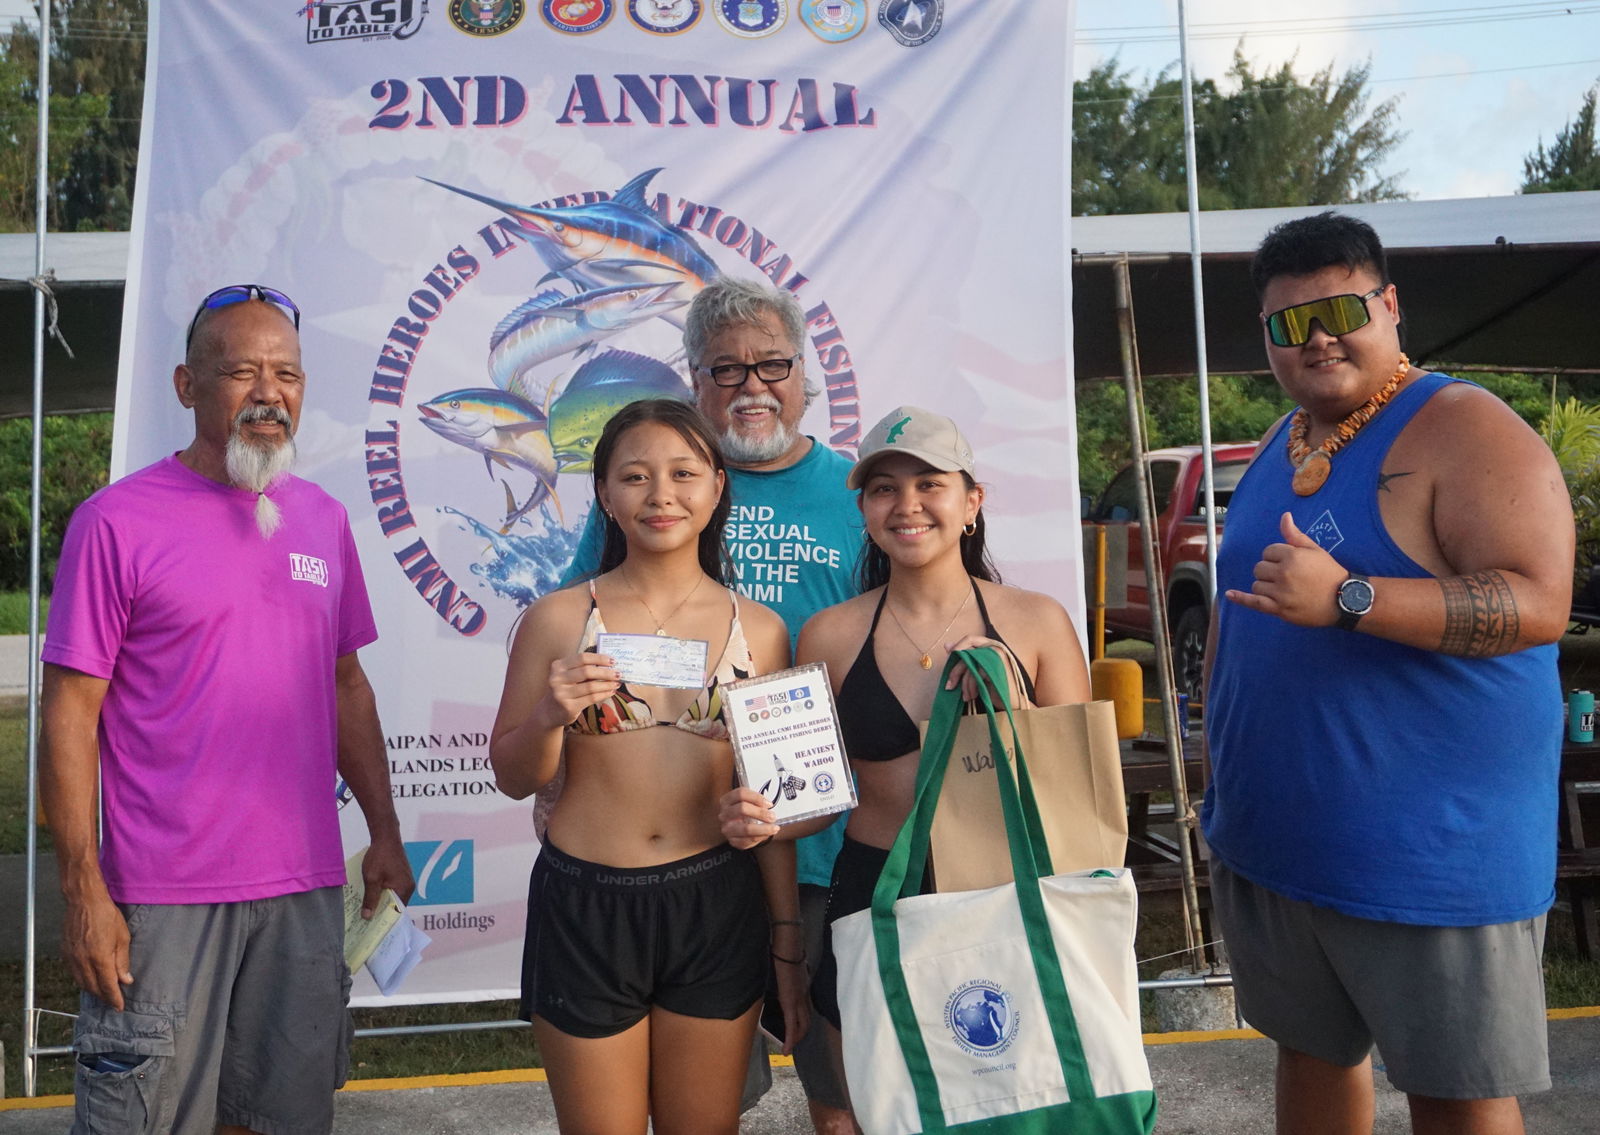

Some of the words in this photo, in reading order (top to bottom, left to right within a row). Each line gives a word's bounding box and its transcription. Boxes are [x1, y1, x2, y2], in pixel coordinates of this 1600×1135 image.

[312, 0, 414, 27] TASI
[312, 28, 334, 39] TO
[339, 24, 395, 36] TABLE
[473, 27, 501, 35] ARMY
[368, 76, 529, 131] 2ND
[555, 74, 878, 133] ANNUAL
[368, 244, 481, 408] HEROES
[365, 420, 417, 539] REEL
[727, 505, 775, 521] END
[724, 523, 816, 541] SEXUAL
[291, 555, 325, 576] TASI
[752, 563, 799, 583] THE
[393, 537, 487, 637] CNMI
[729, 583, 782, 602] NMI
[385, 735, 442, 750] AIPAN
[447, 733, 488, 748] AND
[742, 736, 787, 750] INTERNATIONAL
[789, 729, 813, 739] FISHING
[813, 725, 832, 734] DERBY
[753, 730, 776, 739] ANNUAL
[795, 743, 836, 759] HEAVIEST
[391, 758, 454, 774] LANDS
[803, 755, 834, 768] WAHOO
[391, 781, 497, 798] ELEGATION
[596, 874, 660, 886] UNDER
[663, 850, 733, 882] ARMOUR
[423, 912, 495, 932] Holdings
[943, 1001, 952, 1029] WESTERN
[948, 983, 968, 1001] PACIFIC
[969, 979, 1002, 989] REGIONAL
[951, 1035, 972, 1055] FISHERY
[972, 1038, 1014, 1058] MANAGEMENT
[1010, 1010, 1020, 1041] COUNCIL
[972, 1062, 1017, 1077] wpcouncil.org
